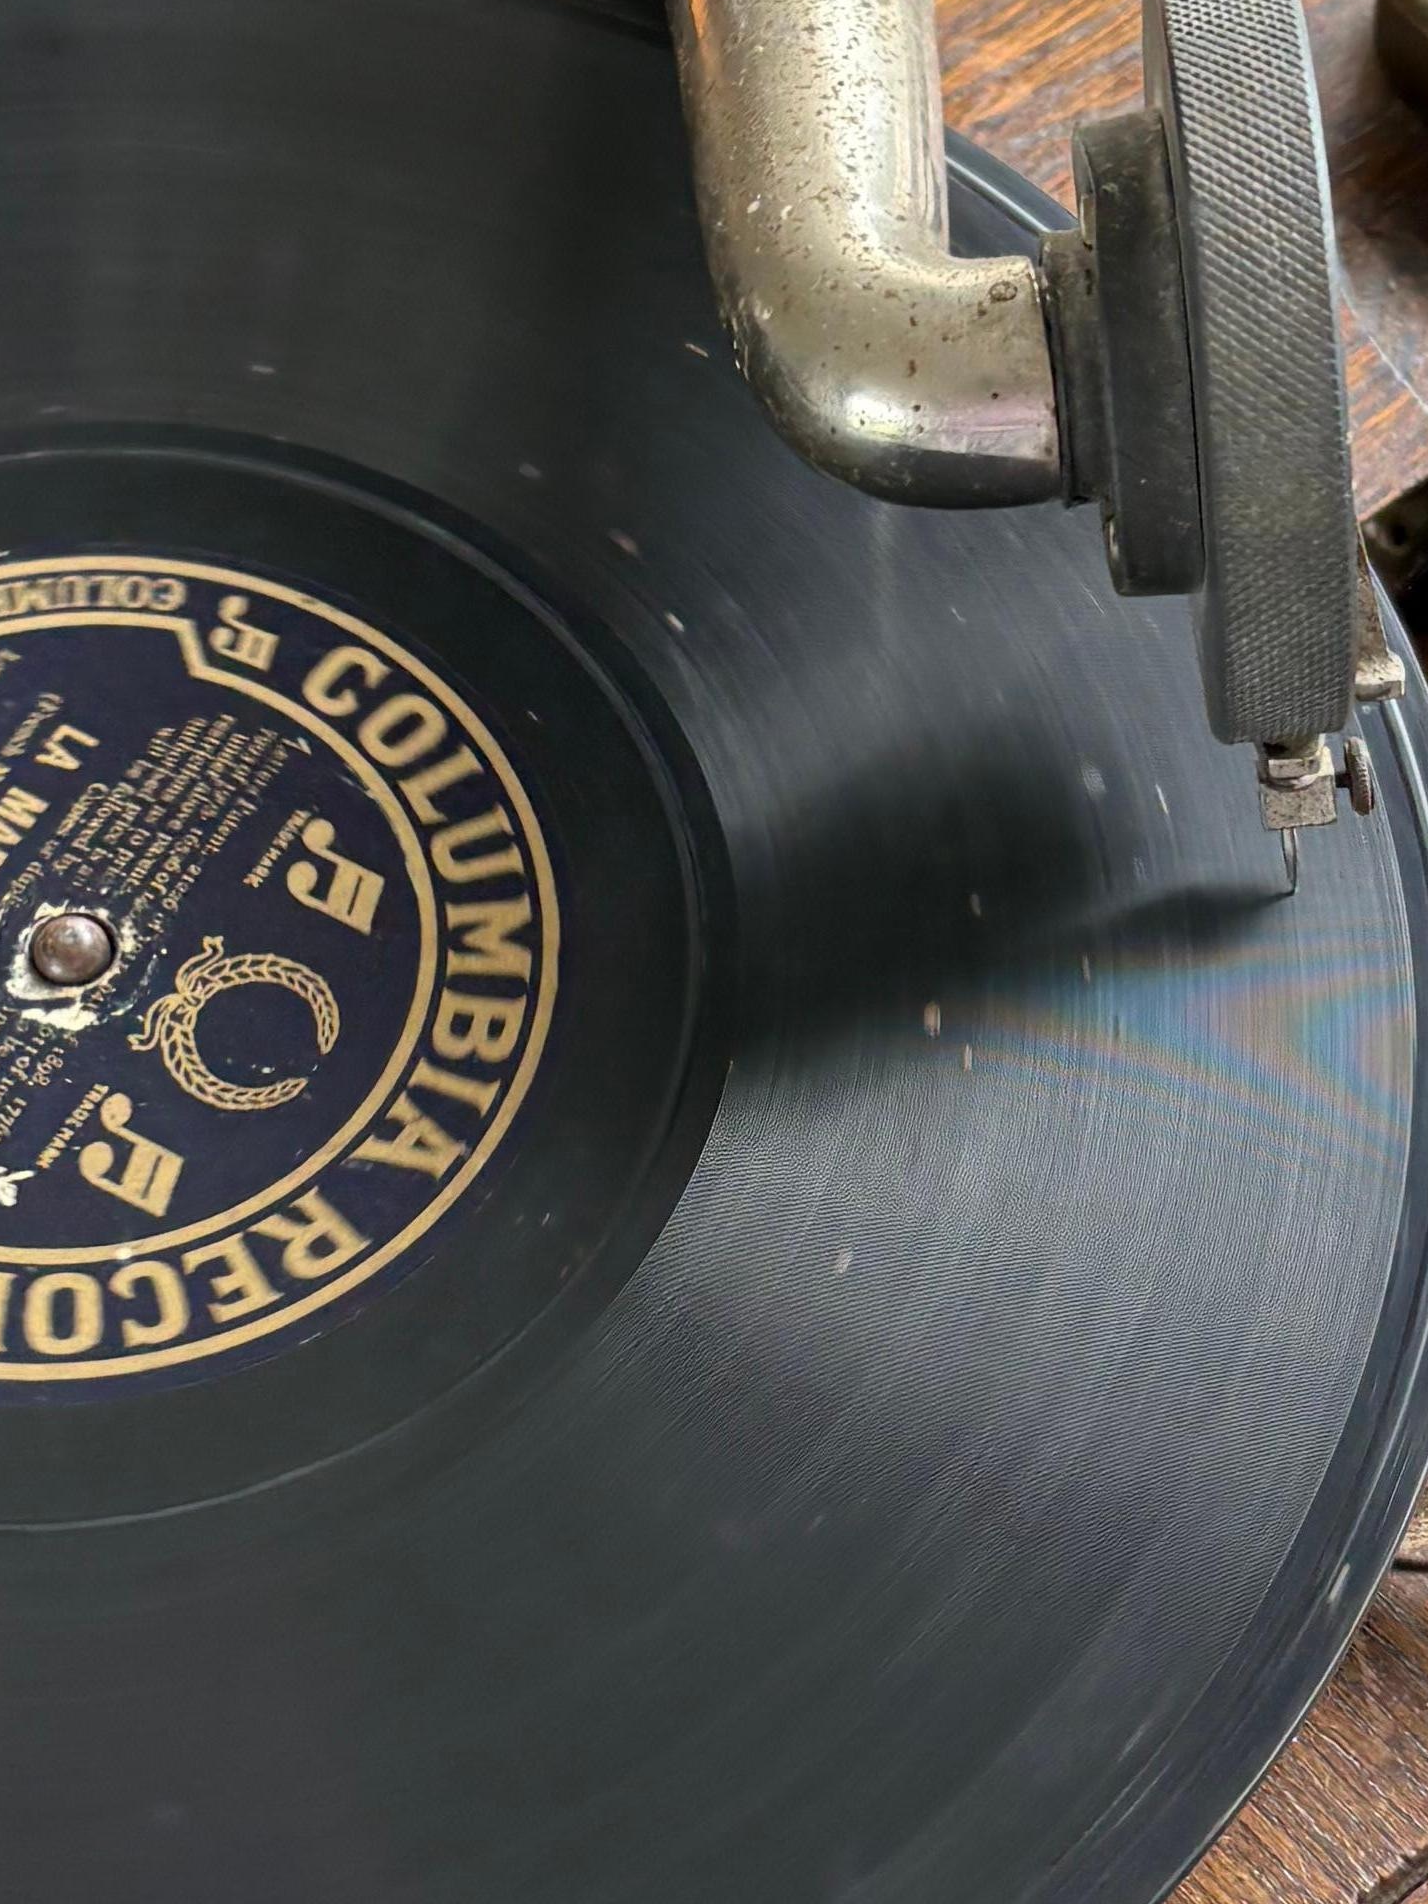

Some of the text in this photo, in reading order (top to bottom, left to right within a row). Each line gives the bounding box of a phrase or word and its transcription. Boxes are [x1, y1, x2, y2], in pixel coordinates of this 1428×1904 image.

[35, 724, 98, 770] LA
[206, 732, 249, 781] under
[56, 782, 108, 836] Copies
[71, 781, 135, 851] followed
[103, 801, 141, 844] price
[167, 781, 210, 830] above
[39, 838, 59, 860] or
[128, 827, 151, 846] to
[149, 871, 169, 895] of
[242, 846, 281, 888] MARK
[302, 646, 533, 1182] COLUMBIA
[9, 1055, 30, 1079] of
[66, 1083, 109, 1127] TRADE
